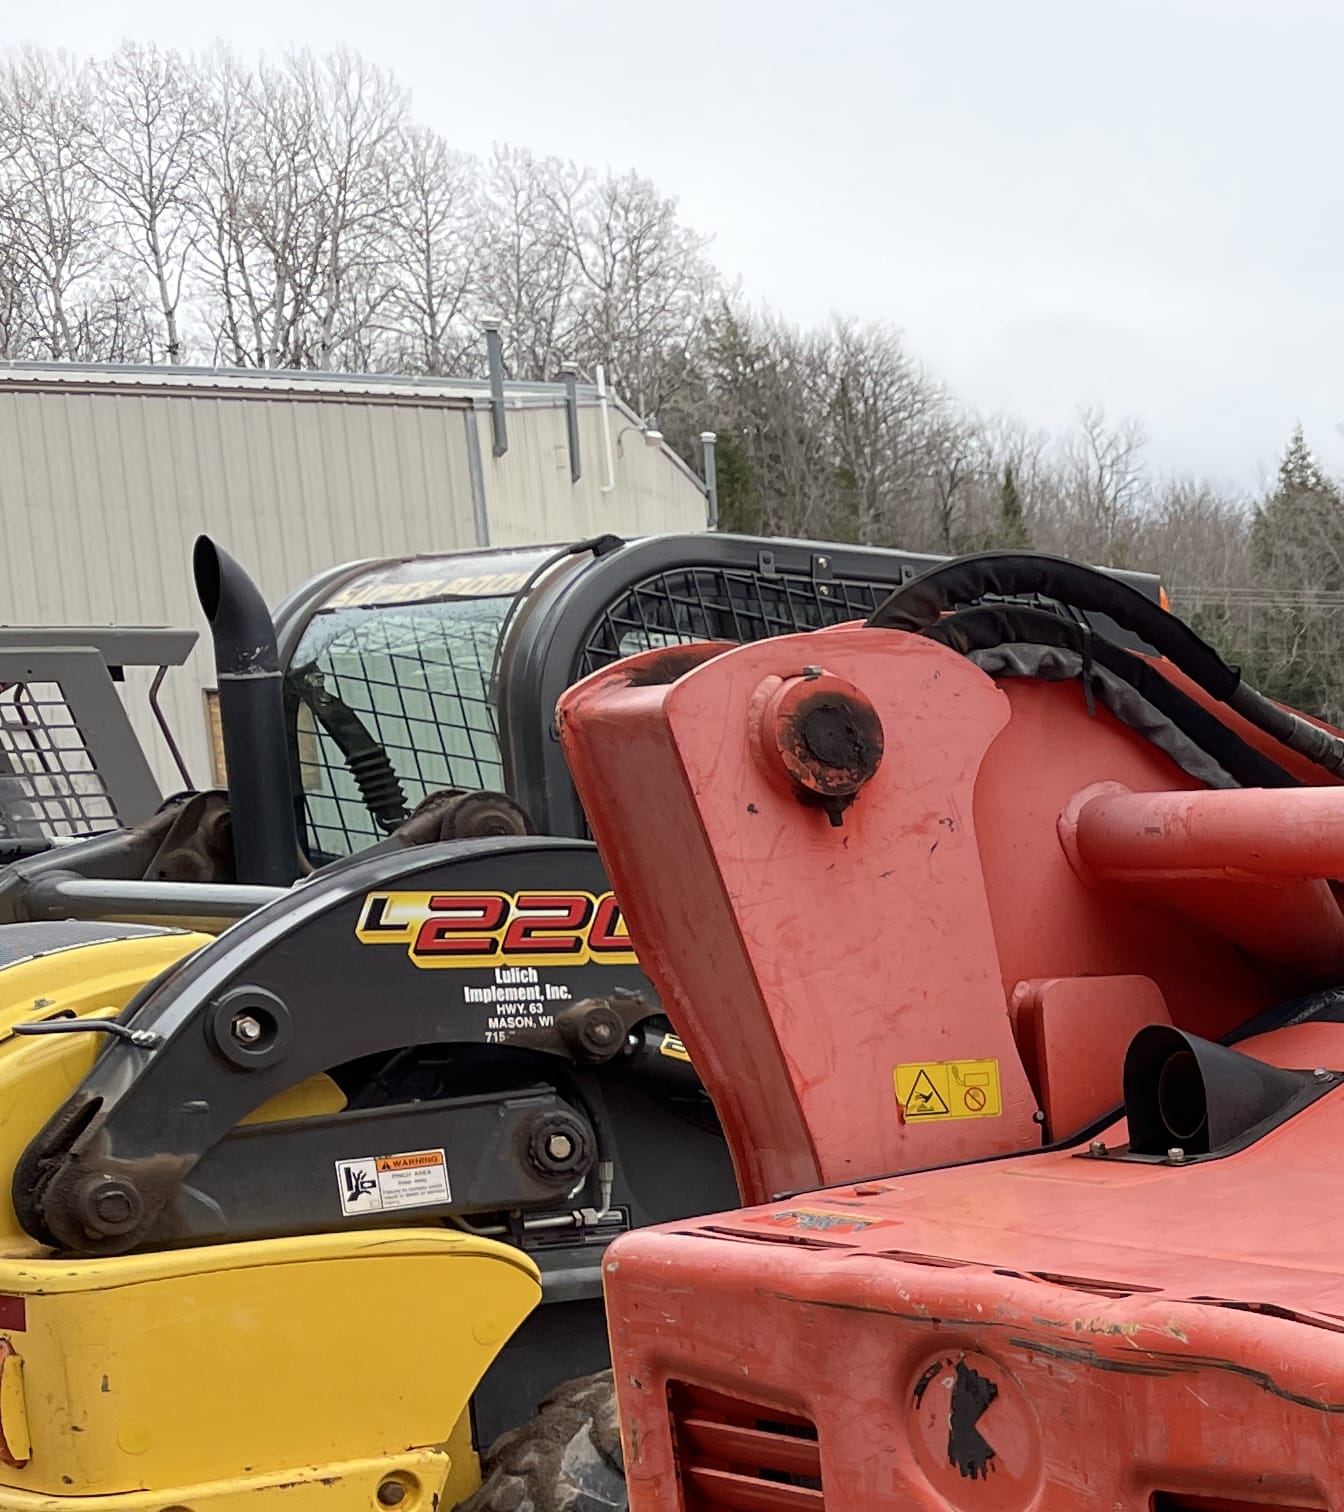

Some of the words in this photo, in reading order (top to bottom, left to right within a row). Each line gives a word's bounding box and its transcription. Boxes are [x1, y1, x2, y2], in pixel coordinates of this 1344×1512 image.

[494, 967, 539, 984] Lulich
[463, 985, 545, 1004] Implement,
[545, 984, 572, 1000] Inc.
[496, 1003, 527, 1015] HWY.
[529, 1003, 544, 1014] 63
[488, 1016, 537, 1029] MASON,
[539, 1015, 554, 1027] WI
[393, 1155, 438, 1167] WARNING
